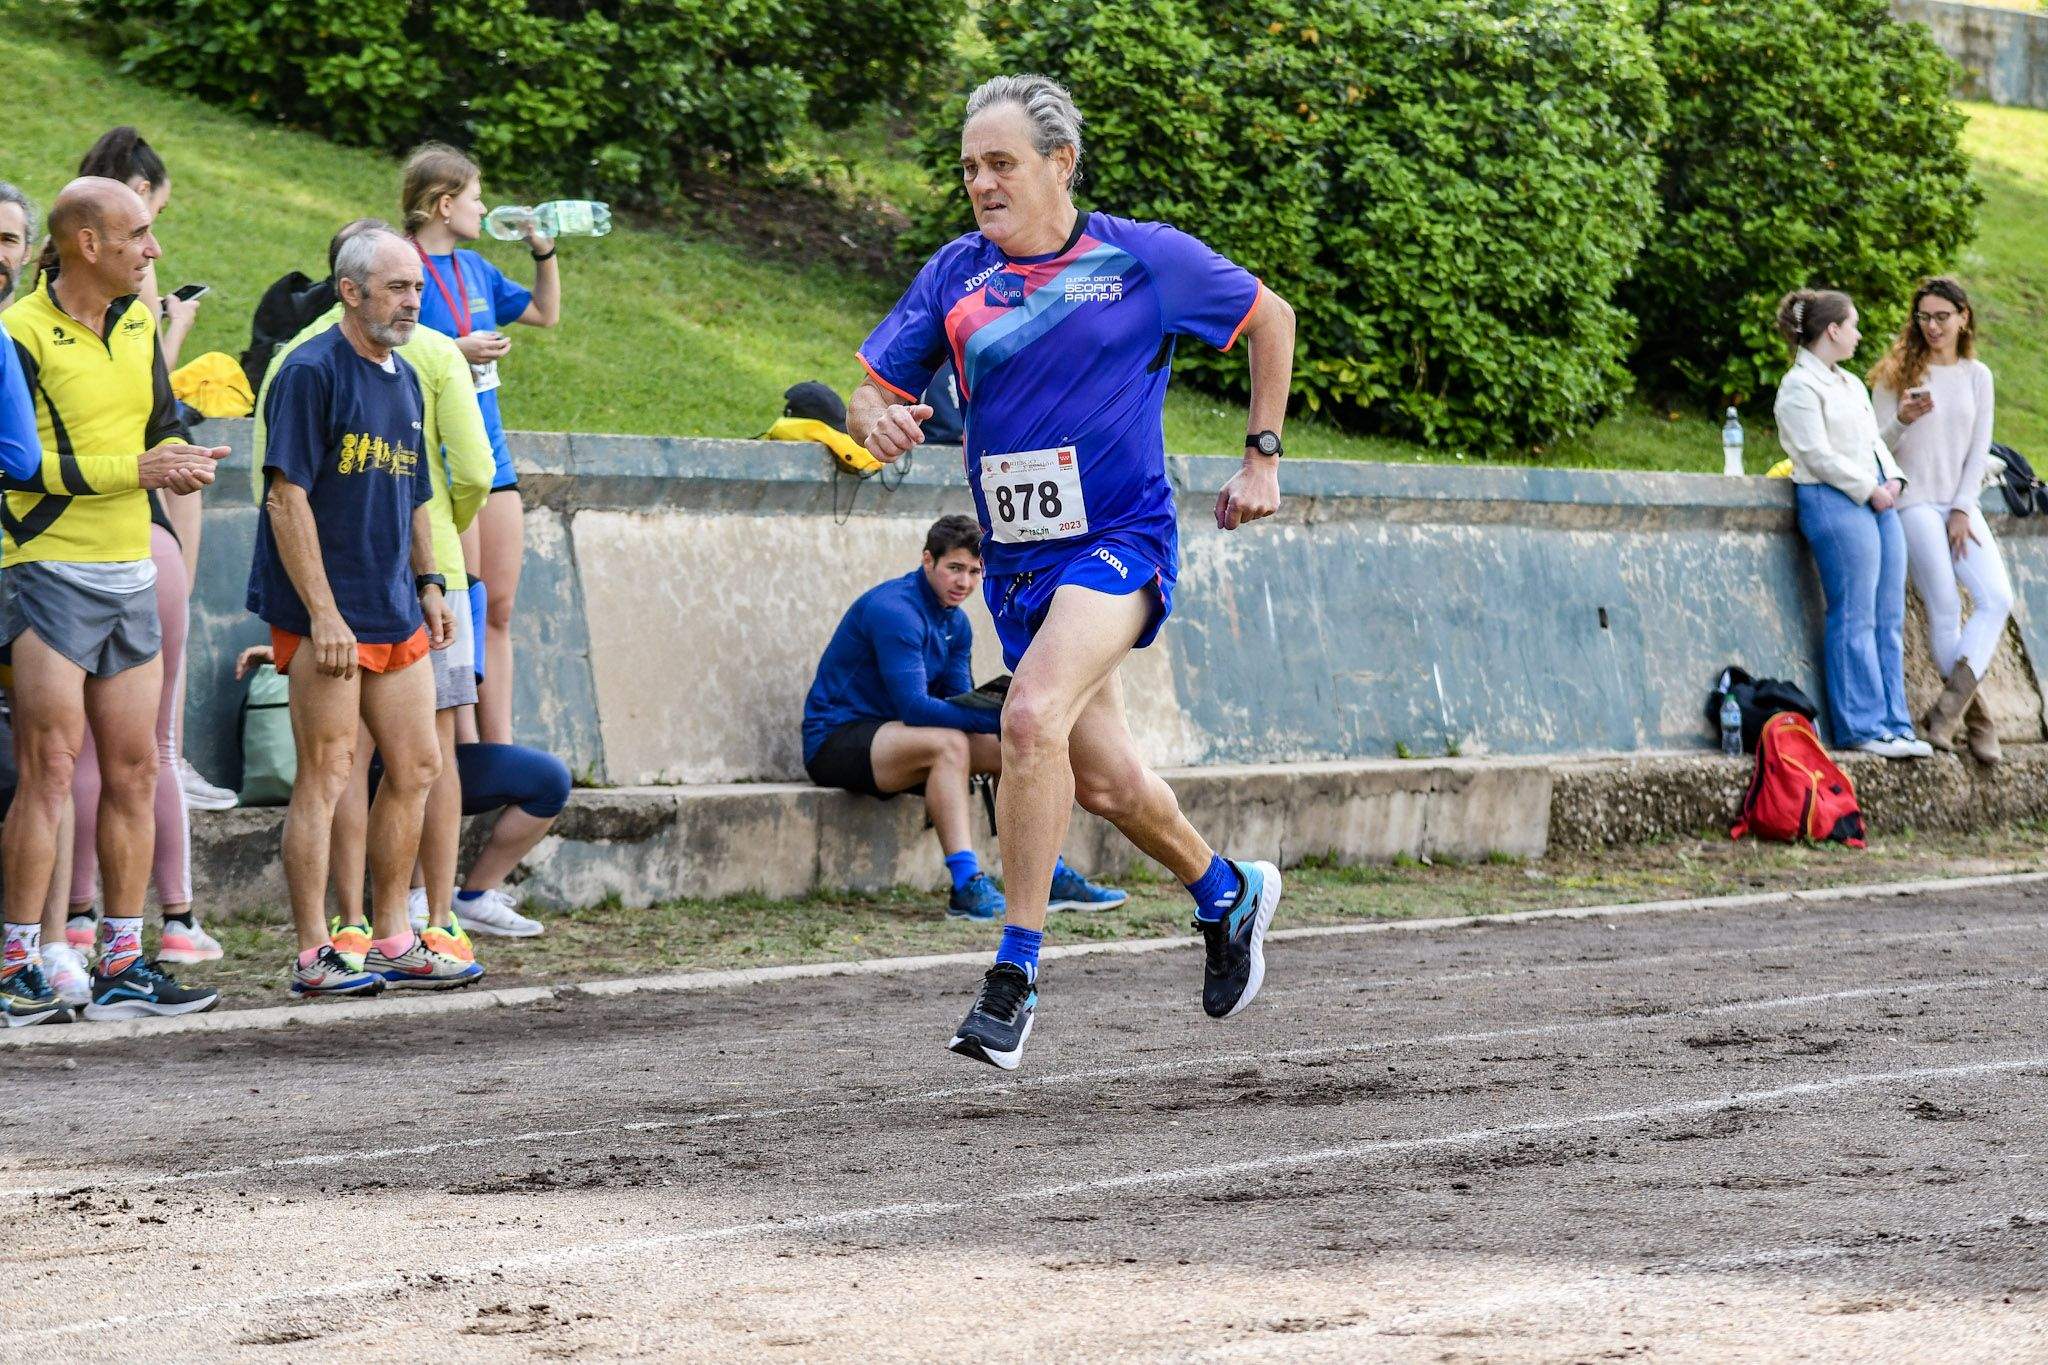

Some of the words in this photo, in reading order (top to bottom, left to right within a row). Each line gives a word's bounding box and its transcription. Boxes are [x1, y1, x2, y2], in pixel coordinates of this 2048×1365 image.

[1065, 282, 1123, 293] SEOANE
[996, 480, 1063, 523] 878
[1059, 520, 1082, 532] 2023
